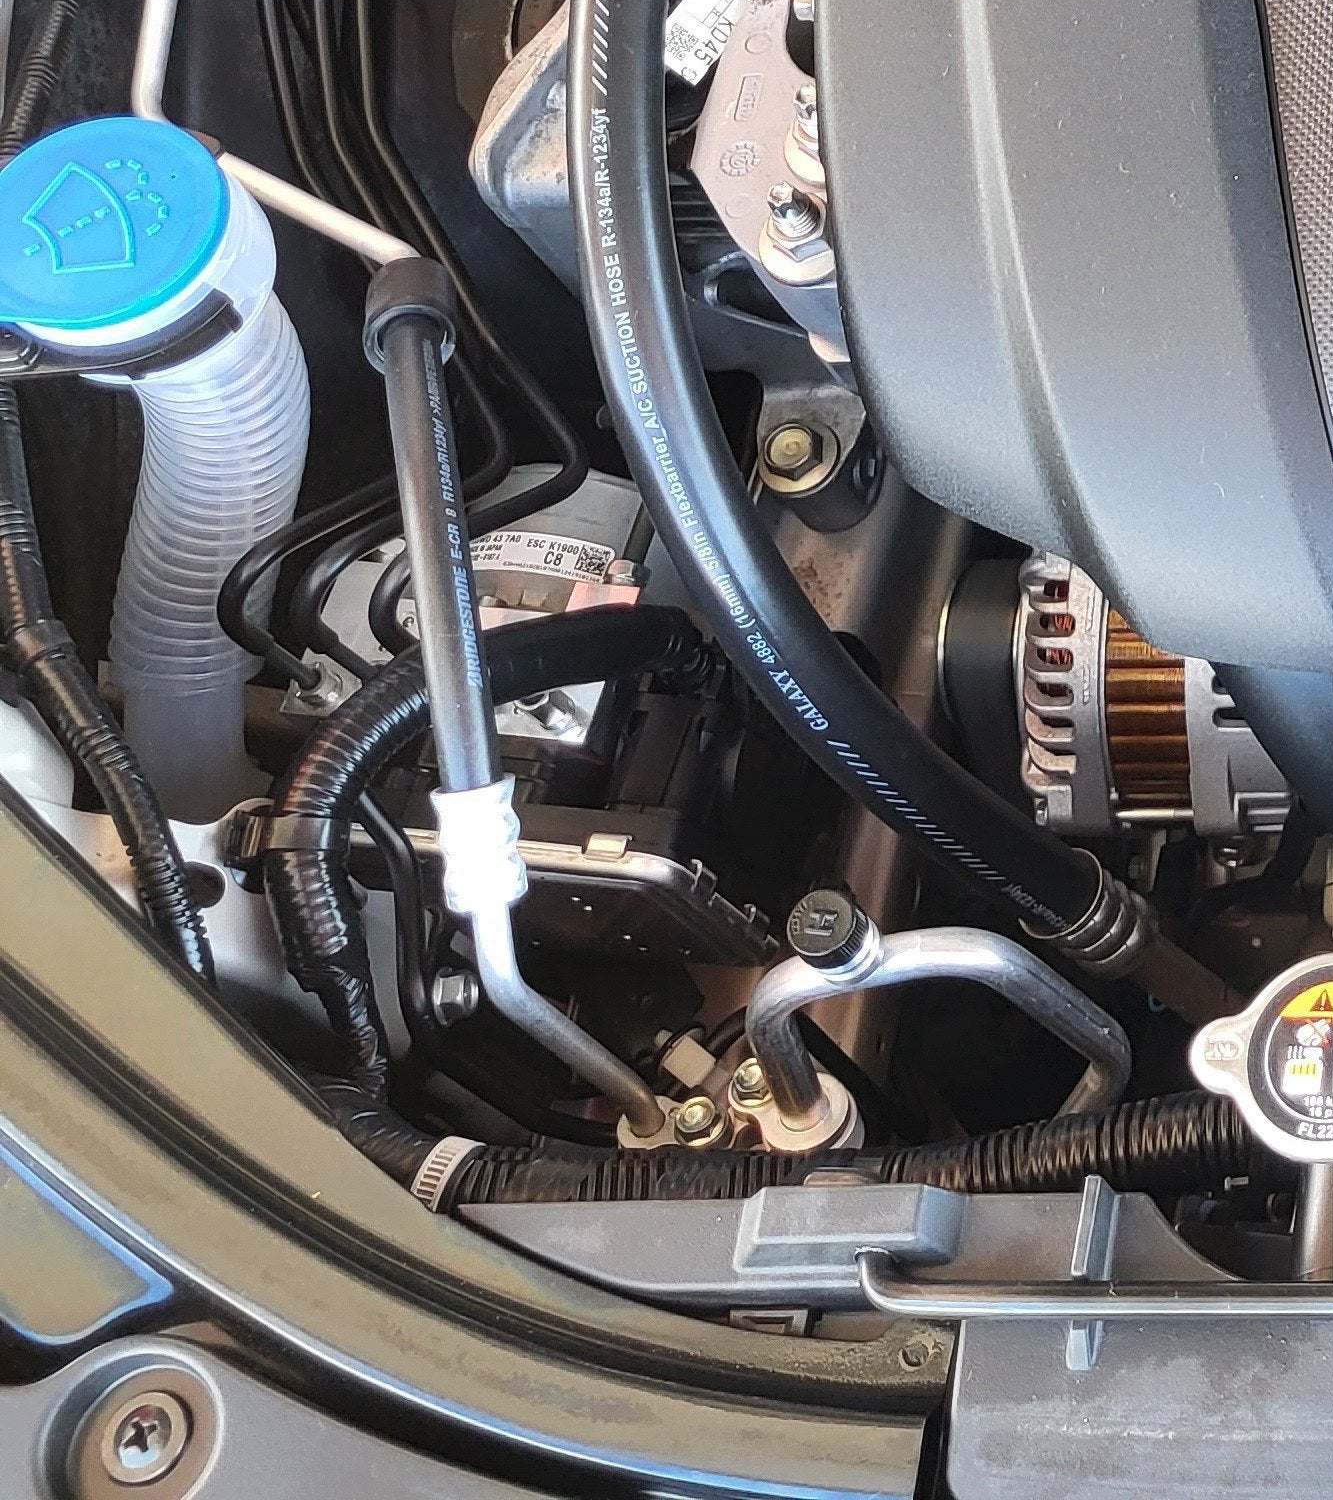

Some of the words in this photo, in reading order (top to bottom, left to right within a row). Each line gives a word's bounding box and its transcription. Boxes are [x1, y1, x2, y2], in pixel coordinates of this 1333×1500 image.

[694, 16, 735, 67] KD45
[591, 107, 617, 248] R-134a/R-1234yf
[603, 253, 627, 308] HOSE
[613, 311, 648, 396] SUCTION
[637, 398, 660, 430] A/C
[651, 434, 698, 529] Flexbarrier
[445, 507, 458, 518] 8
[447, 523, 463, 561] E-CR
[493, 534, 503, 543] 43
[526, 538, 545, 549] ESC
[548, 541, 579, 555] K1900
[543, 551, 563, 567] C8
[453, 565, 484, 689] BRIDGESTONE
[712, 573, 757, 630] (16mm)
[745, 631, 776, 665] 4882
[768, 669, 830, 732] GALAXY
